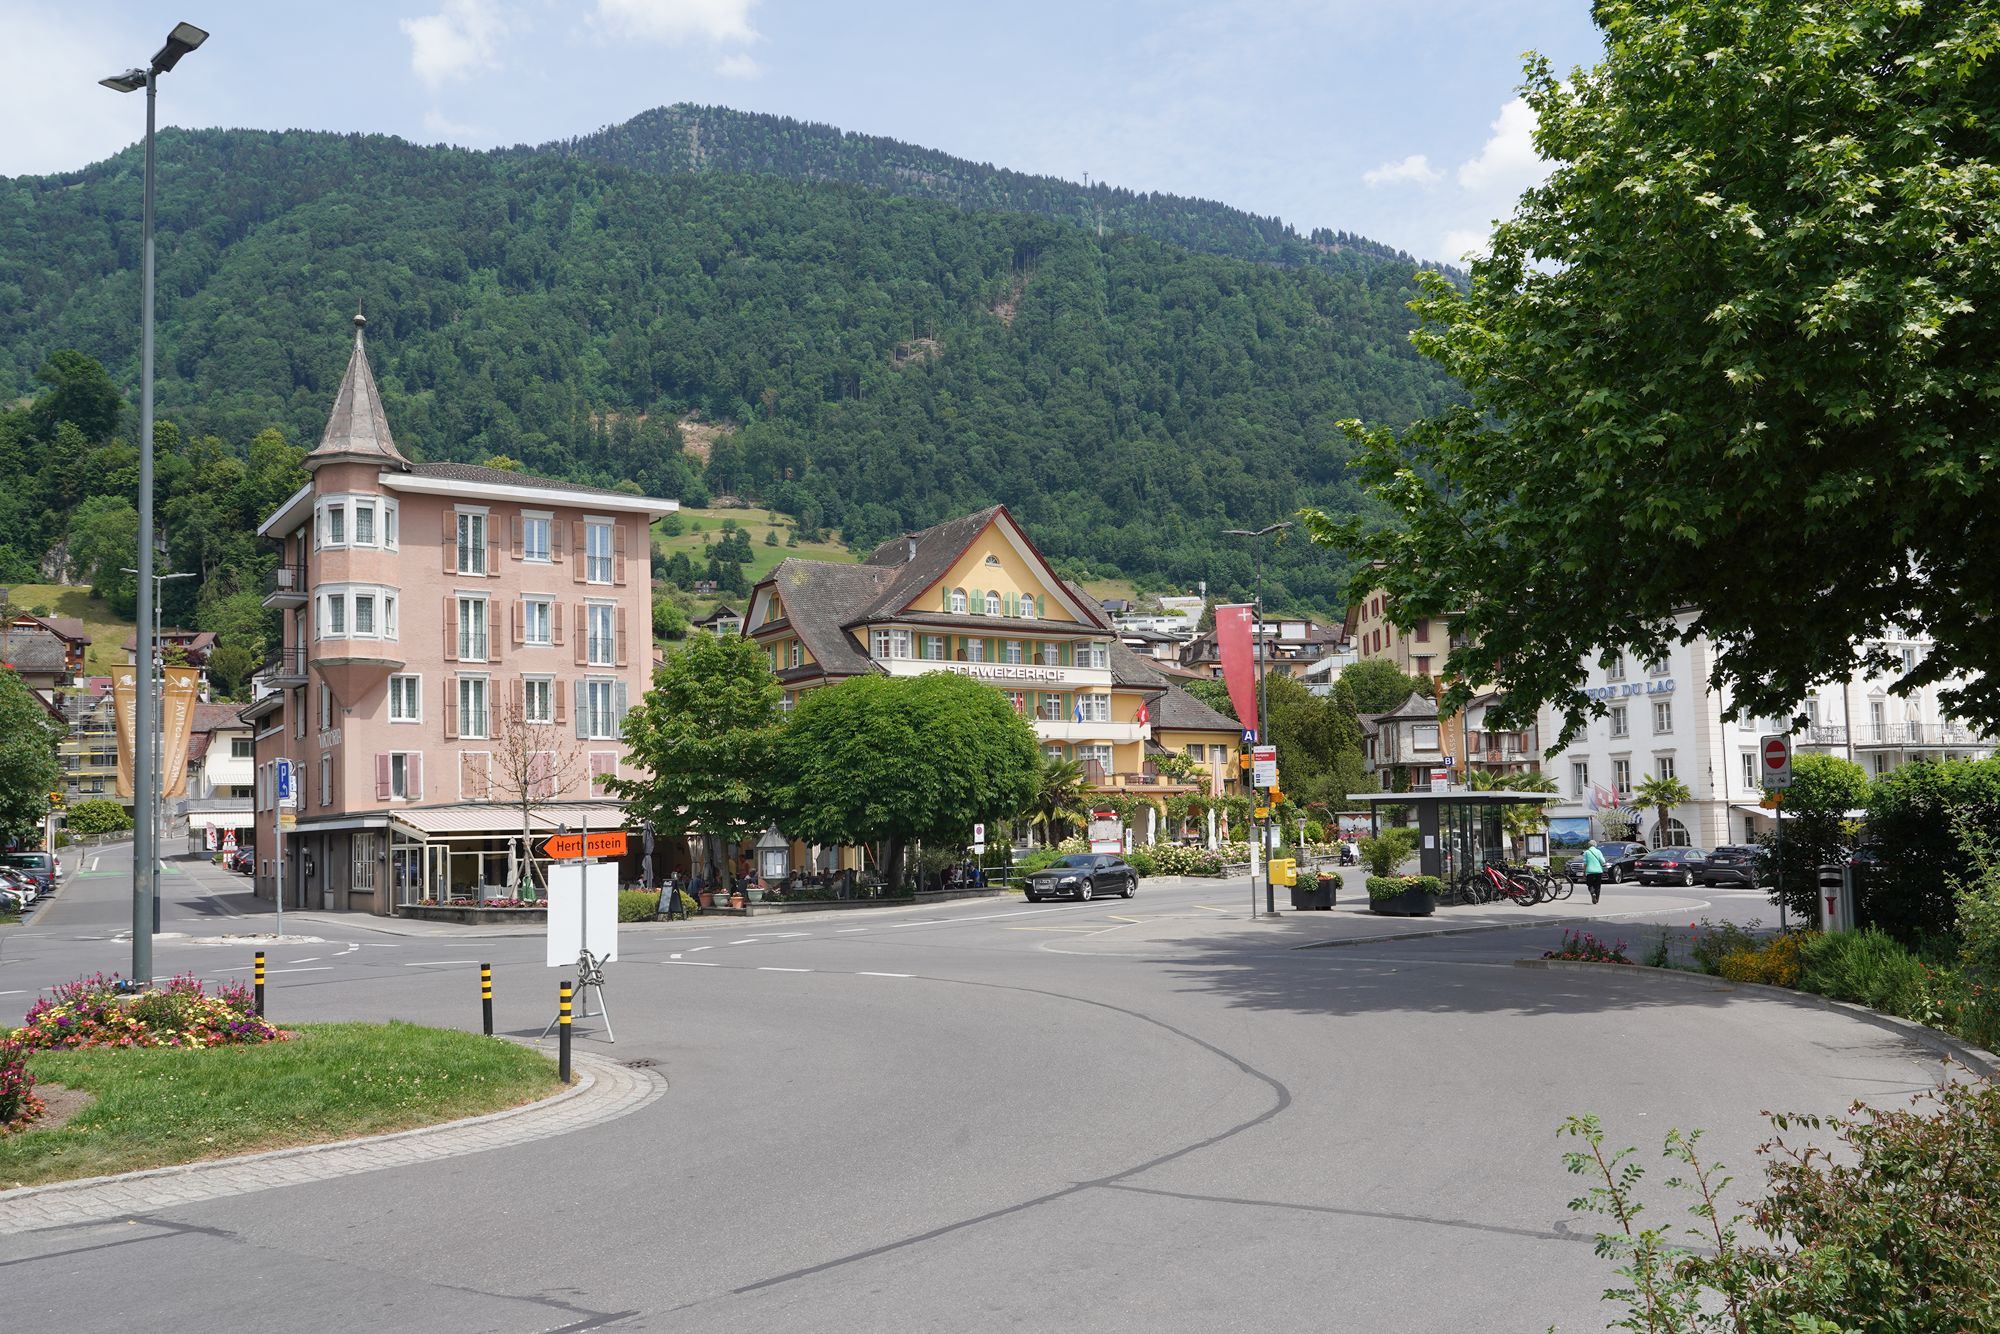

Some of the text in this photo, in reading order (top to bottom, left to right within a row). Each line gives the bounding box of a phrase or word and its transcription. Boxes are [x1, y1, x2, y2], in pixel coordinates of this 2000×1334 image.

[946, 665, 1065, 681] SCHWEIZERHOF
[1621, 683, 1642, 697] DU
[1646, 679, 1676, 694] LAC
[1244, 731, 1253, 741] A
[1444, 757, 1452, 765] B
[281, 765, 287, 783] P
[556, 837, 621, 852] Hertnstein
